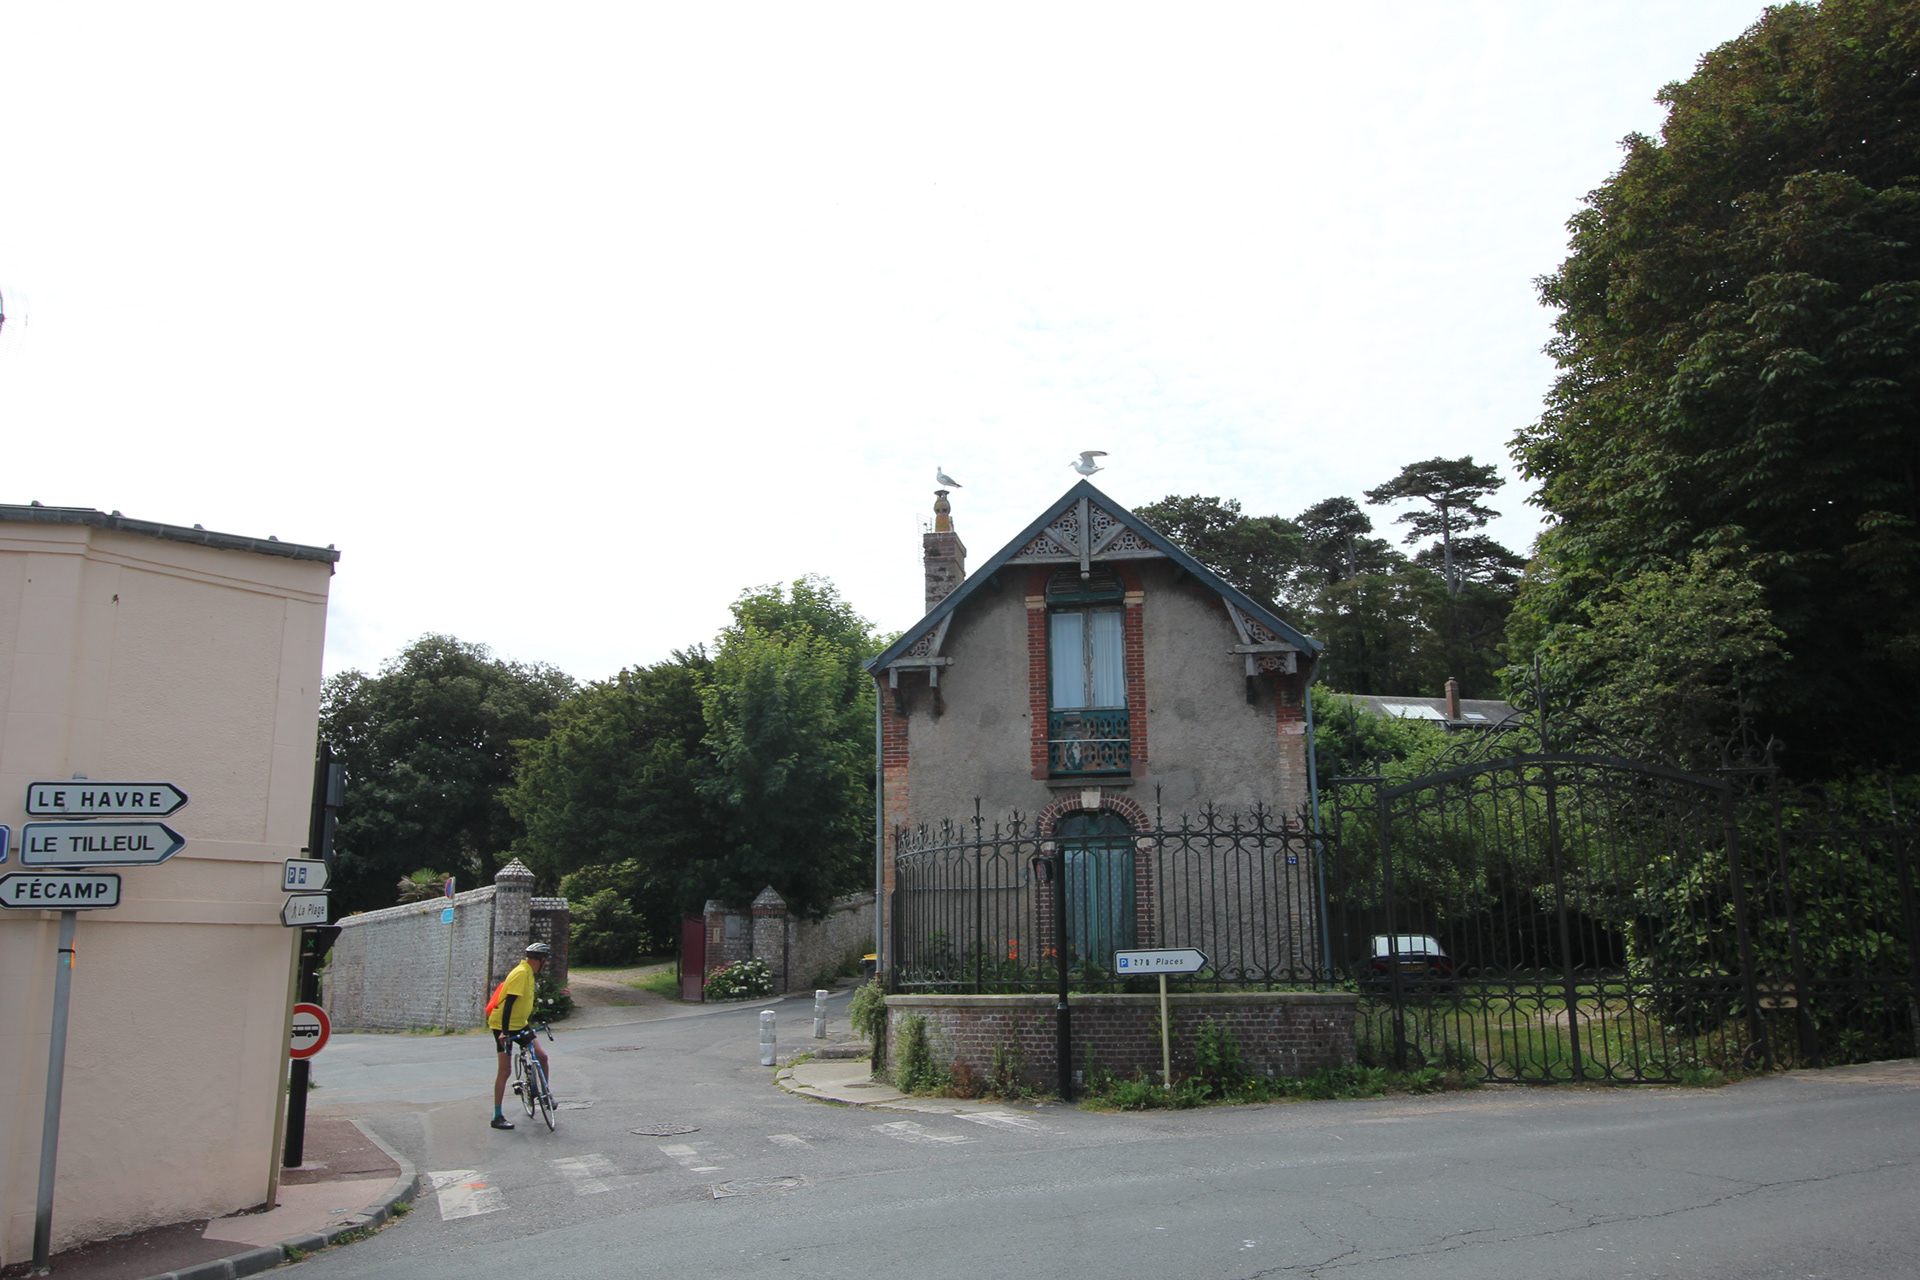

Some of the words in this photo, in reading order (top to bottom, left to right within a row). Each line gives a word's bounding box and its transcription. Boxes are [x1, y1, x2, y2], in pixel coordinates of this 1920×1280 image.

[38, 791, 66, 807] LE
[81, 791, 161, 807] HAVRE
[30, 837, 58, 853] LE
[69, 835, 155, 852] TILLEUL
[15, 878, 108, 899] FÉCAMP
[298, 904, 305, 916] La
[307, 903, 325, 918] Plage
[1155, 957, 1184, 965] Places
